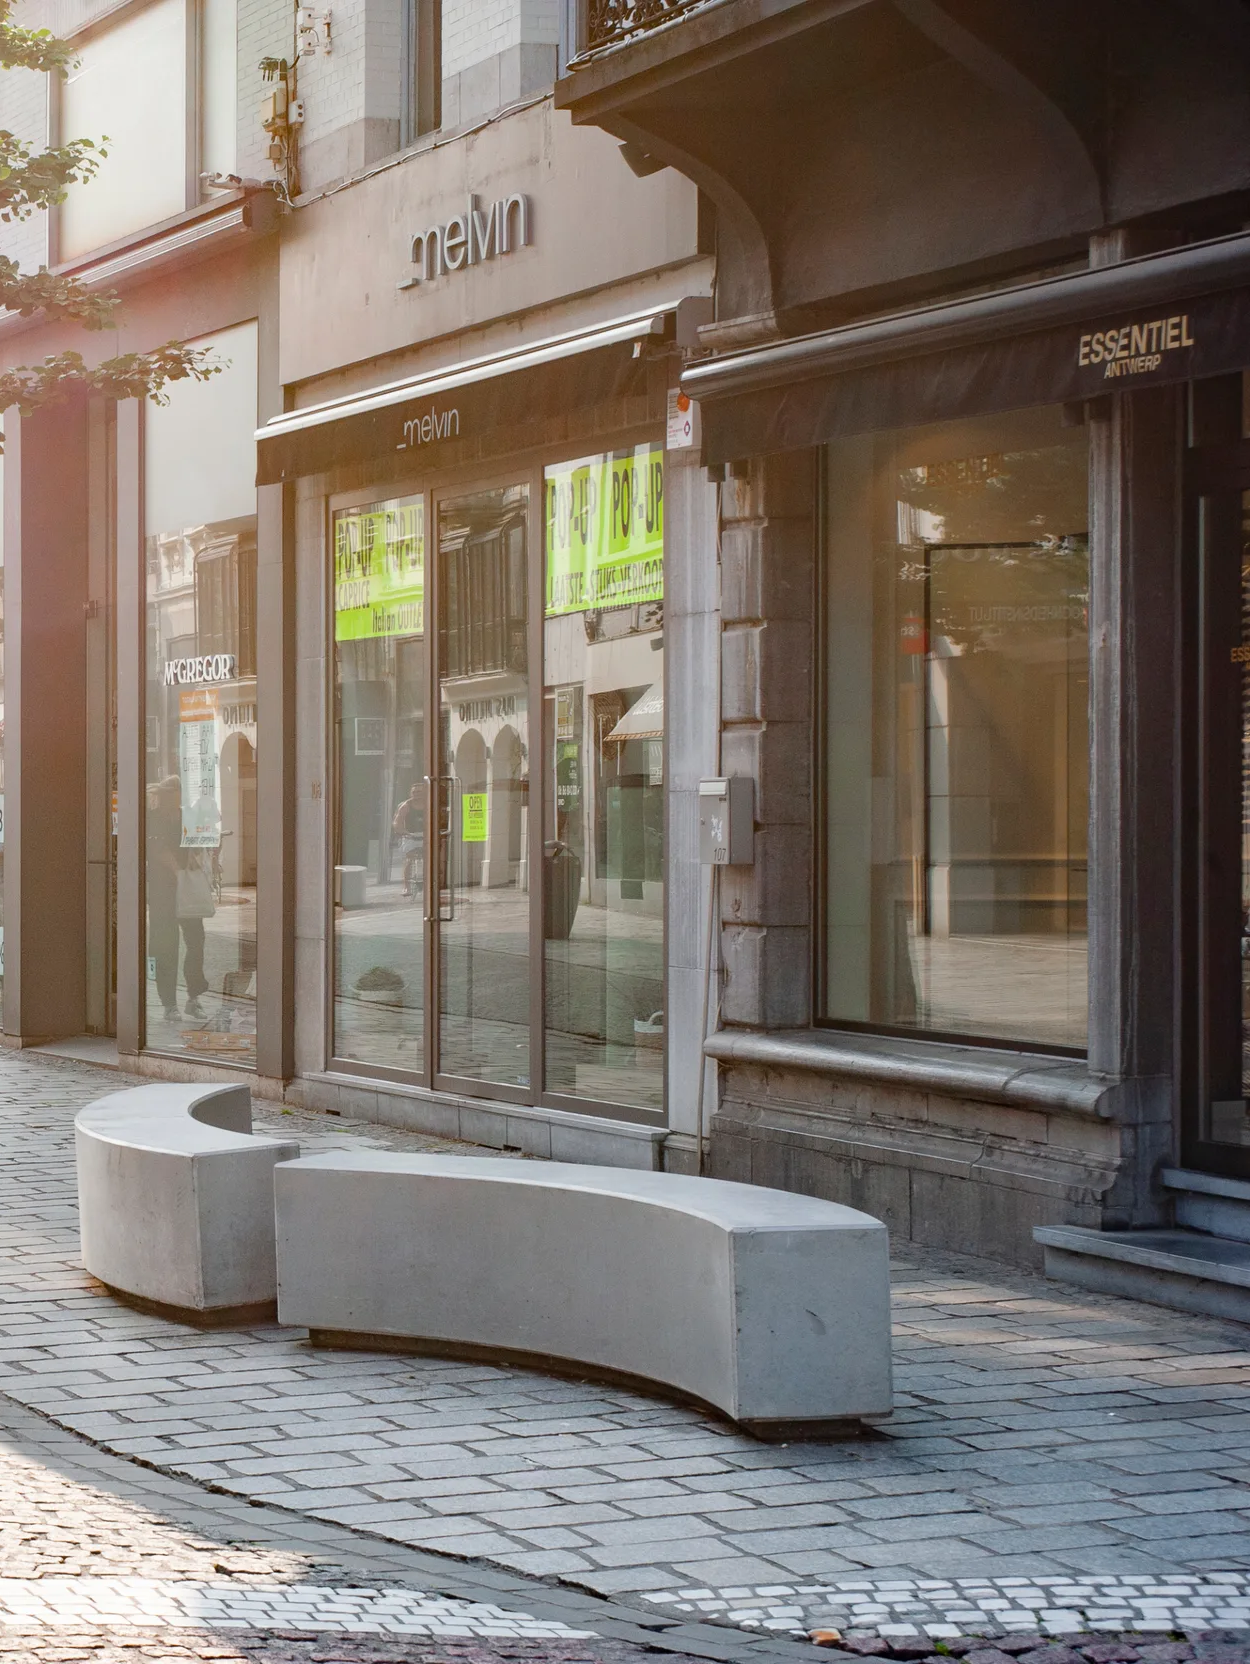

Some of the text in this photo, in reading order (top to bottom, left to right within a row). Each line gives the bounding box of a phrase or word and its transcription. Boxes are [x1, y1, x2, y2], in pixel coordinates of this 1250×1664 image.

[1078, 314, 1195, 367] ESSENTIEL
[1103, 353, 1162, 379] ANTWERP
[551, 475, 597, 551] POP-UP
[613, 461, 663, 540] POP-UP
[338, 579, 370, 612] CAPRICE
[397, 601, 424, 631] OUTLE
[714, 847, 727, 862] 107
